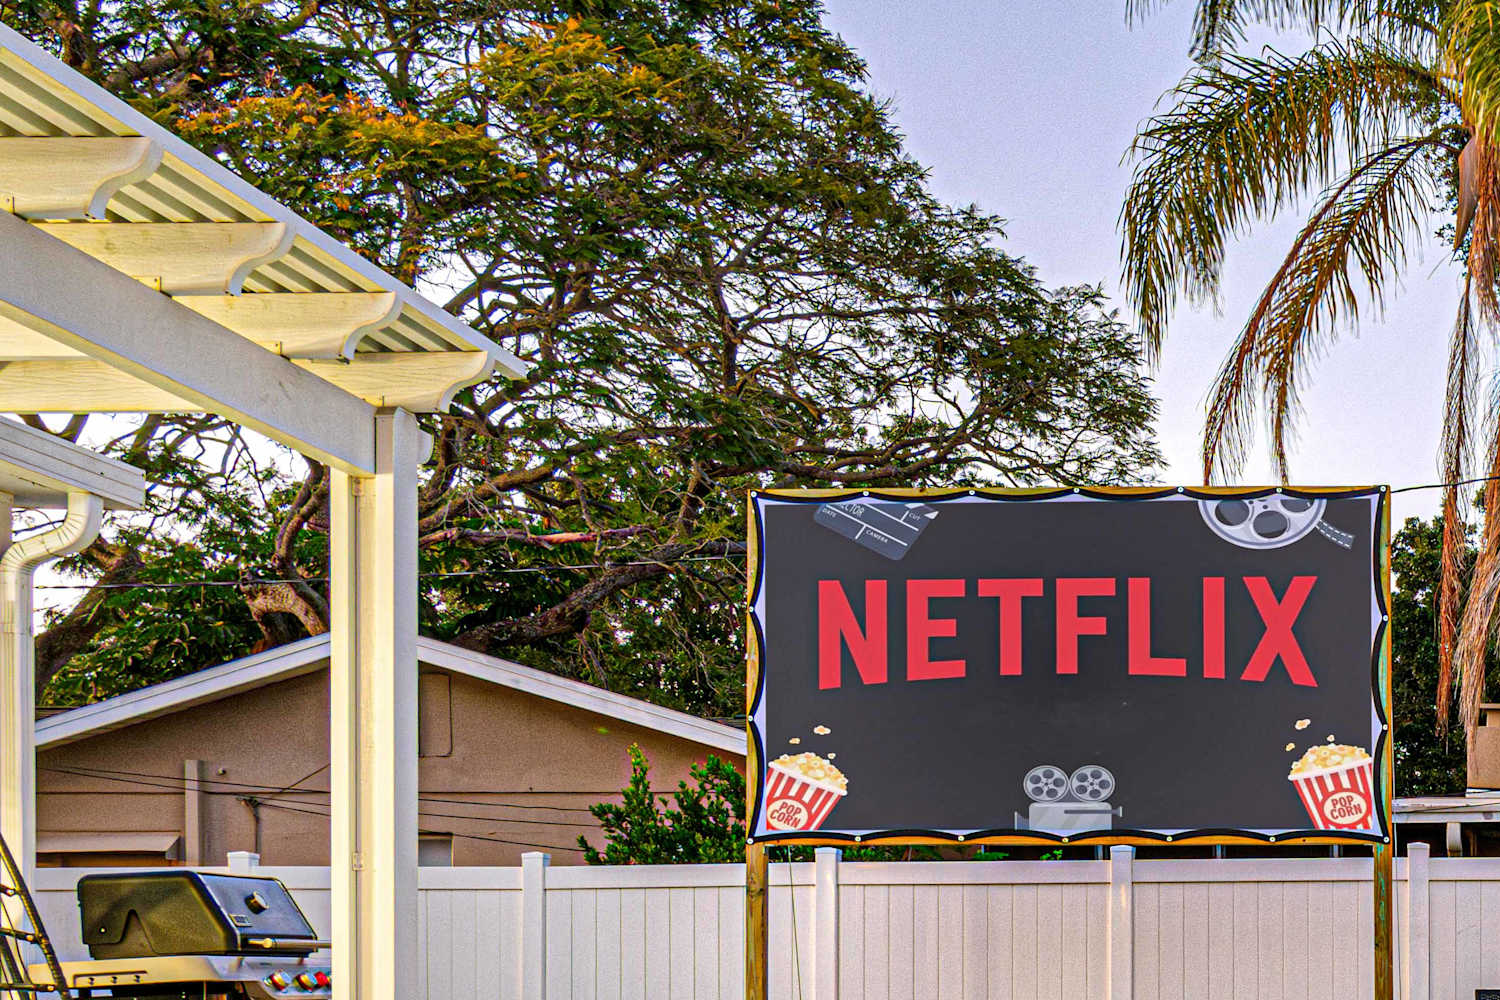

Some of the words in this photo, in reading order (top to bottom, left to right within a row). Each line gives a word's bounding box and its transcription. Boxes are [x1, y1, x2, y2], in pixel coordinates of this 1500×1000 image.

[822, 507, 837, 518] DATE
[908, 511, 921, 521] CUT
[865, 529, 888, 543] CAMERA
[818, 576, 1318, 690] NETFLIX
[779, 801, 802, 816] POP
[1331, 795, 1354, 808] POP
[770, 809, 801, 828] CORN
[1330, 803, 1362, 820] CORN
